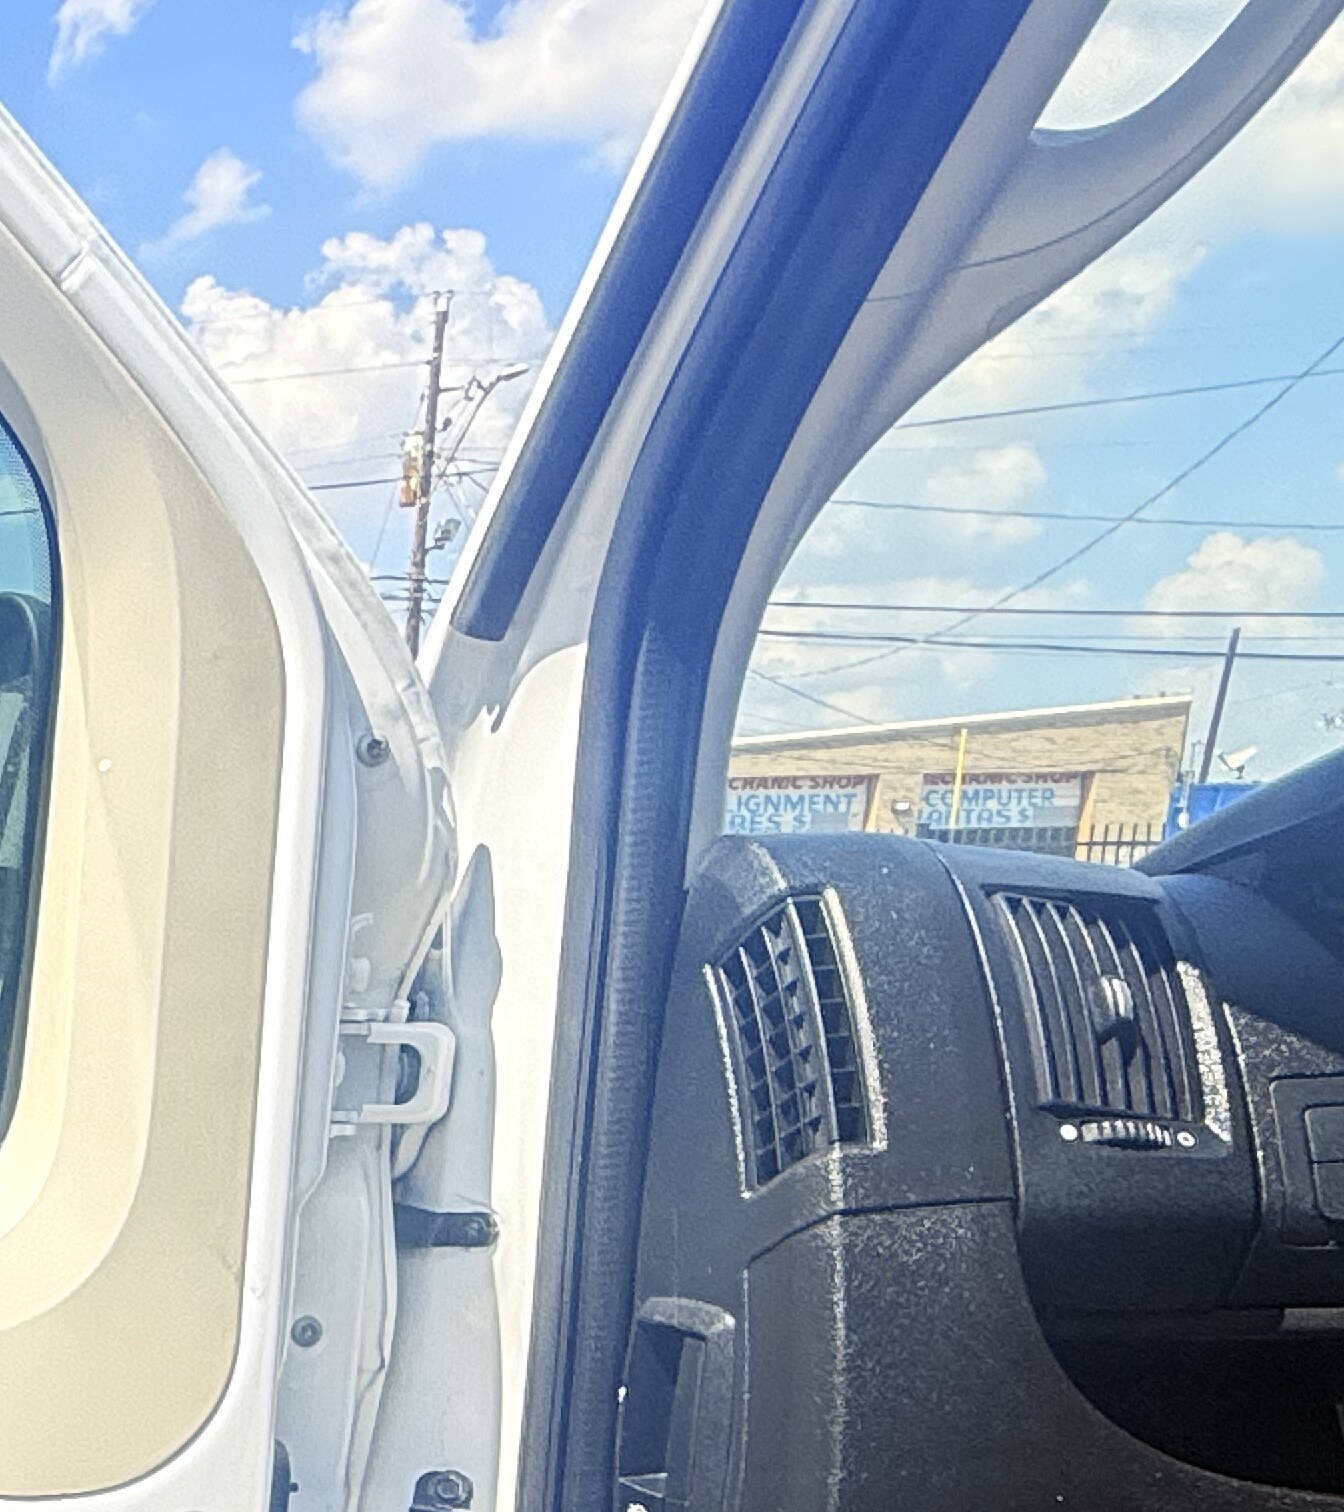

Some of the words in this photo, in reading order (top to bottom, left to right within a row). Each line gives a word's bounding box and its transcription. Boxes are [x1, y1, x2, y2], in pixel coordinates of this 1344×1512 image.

[809, 775, 865, 790] SHOP
[728, 792, 858, 814] IGNMENT
[924, 787, 1055, 809] COMPUTER
